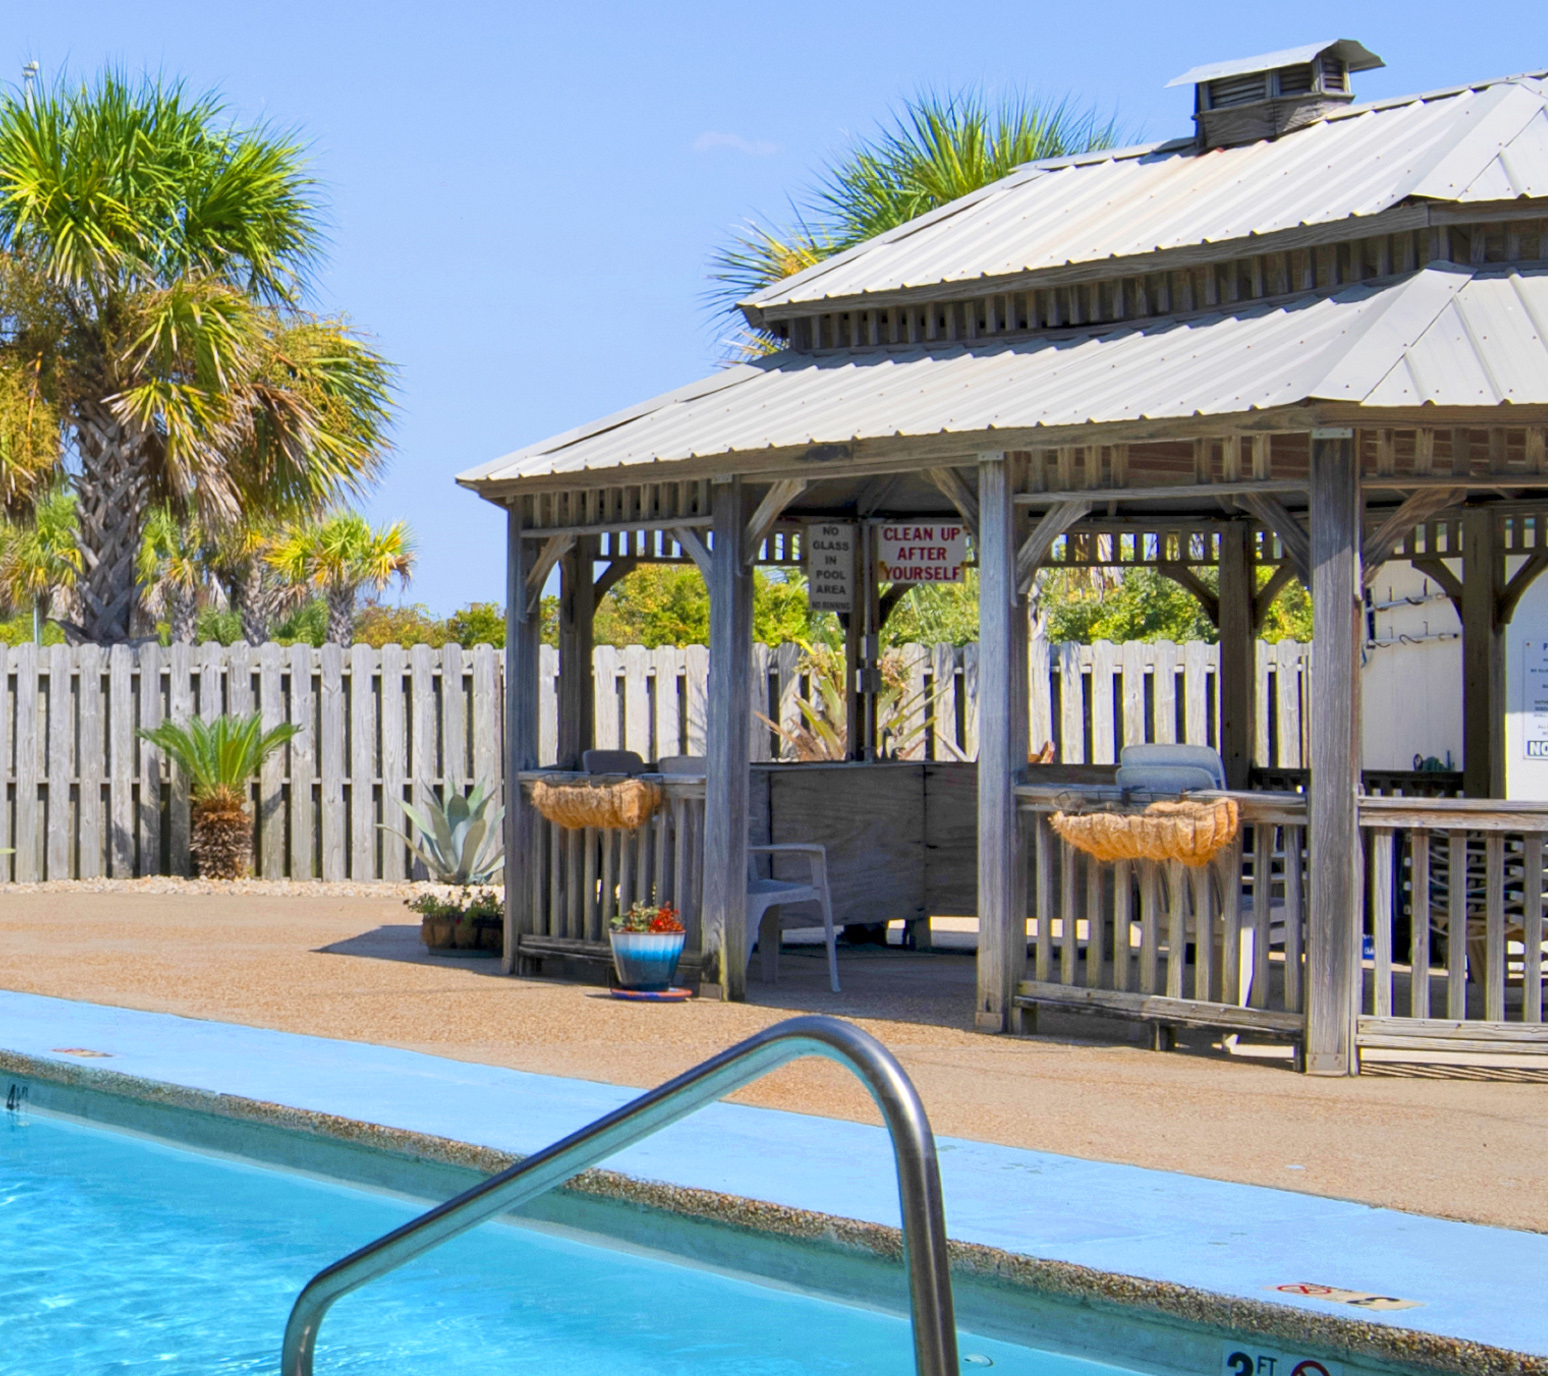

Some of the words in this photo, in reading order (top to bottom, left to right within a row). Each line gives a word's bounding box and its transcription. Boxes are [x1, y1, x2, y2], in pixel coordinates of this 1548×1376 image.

[823, 526, 839, 536] NO
[883, 527, 933, 541] CLEAN
[941, 527, 960, 541] UP
[813, 540, 849, 551] GLASS
[897, 547, 947, 560] AFTER
[825, 555, 837, 565] IN
[816, 569, 846, 580] POOL
[884, 566, 960, 581] YOURSELF
[816, 584, 846, 595] AREA
[1257, 1355, 1278, 1376] FT
